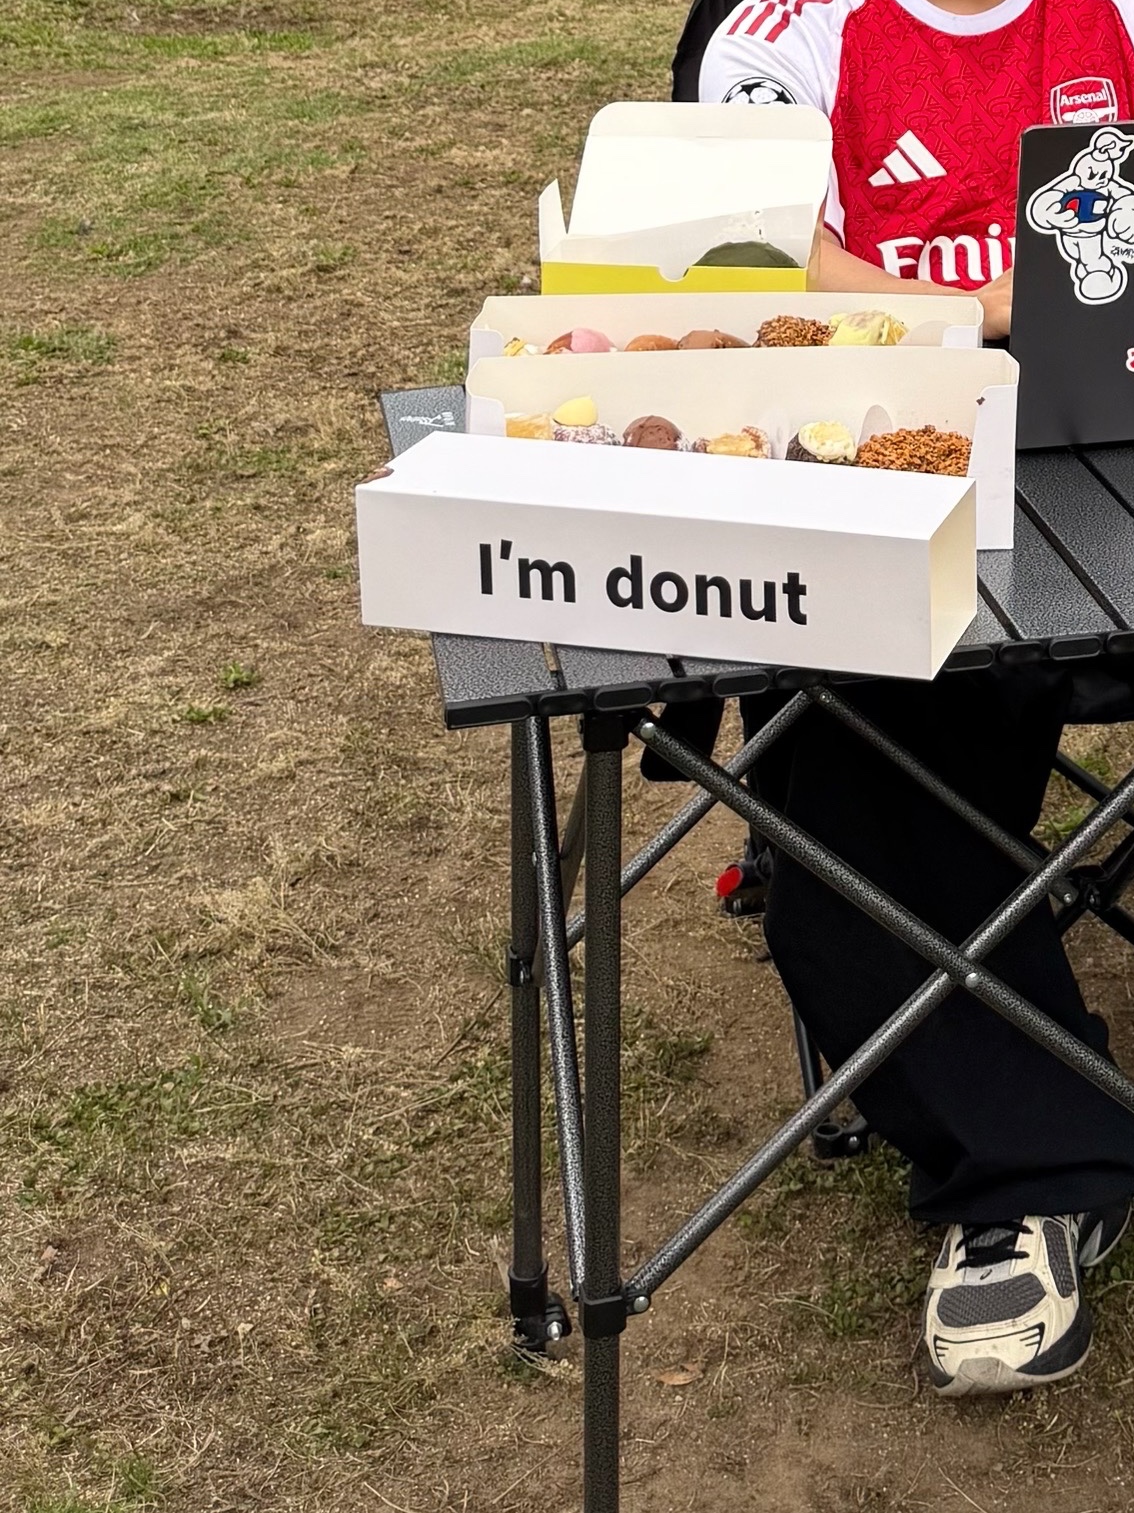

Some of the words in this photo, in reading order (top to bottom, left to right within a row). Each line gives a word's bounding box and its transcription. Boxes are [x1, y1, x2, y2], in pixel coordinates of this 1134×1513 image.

[1060, 89, 1107, 106] Arsenal
[876, 223, 1016, 282] Emi
[479, 539, 576, 603] I'm
[606, 554, 807, 625] donut
